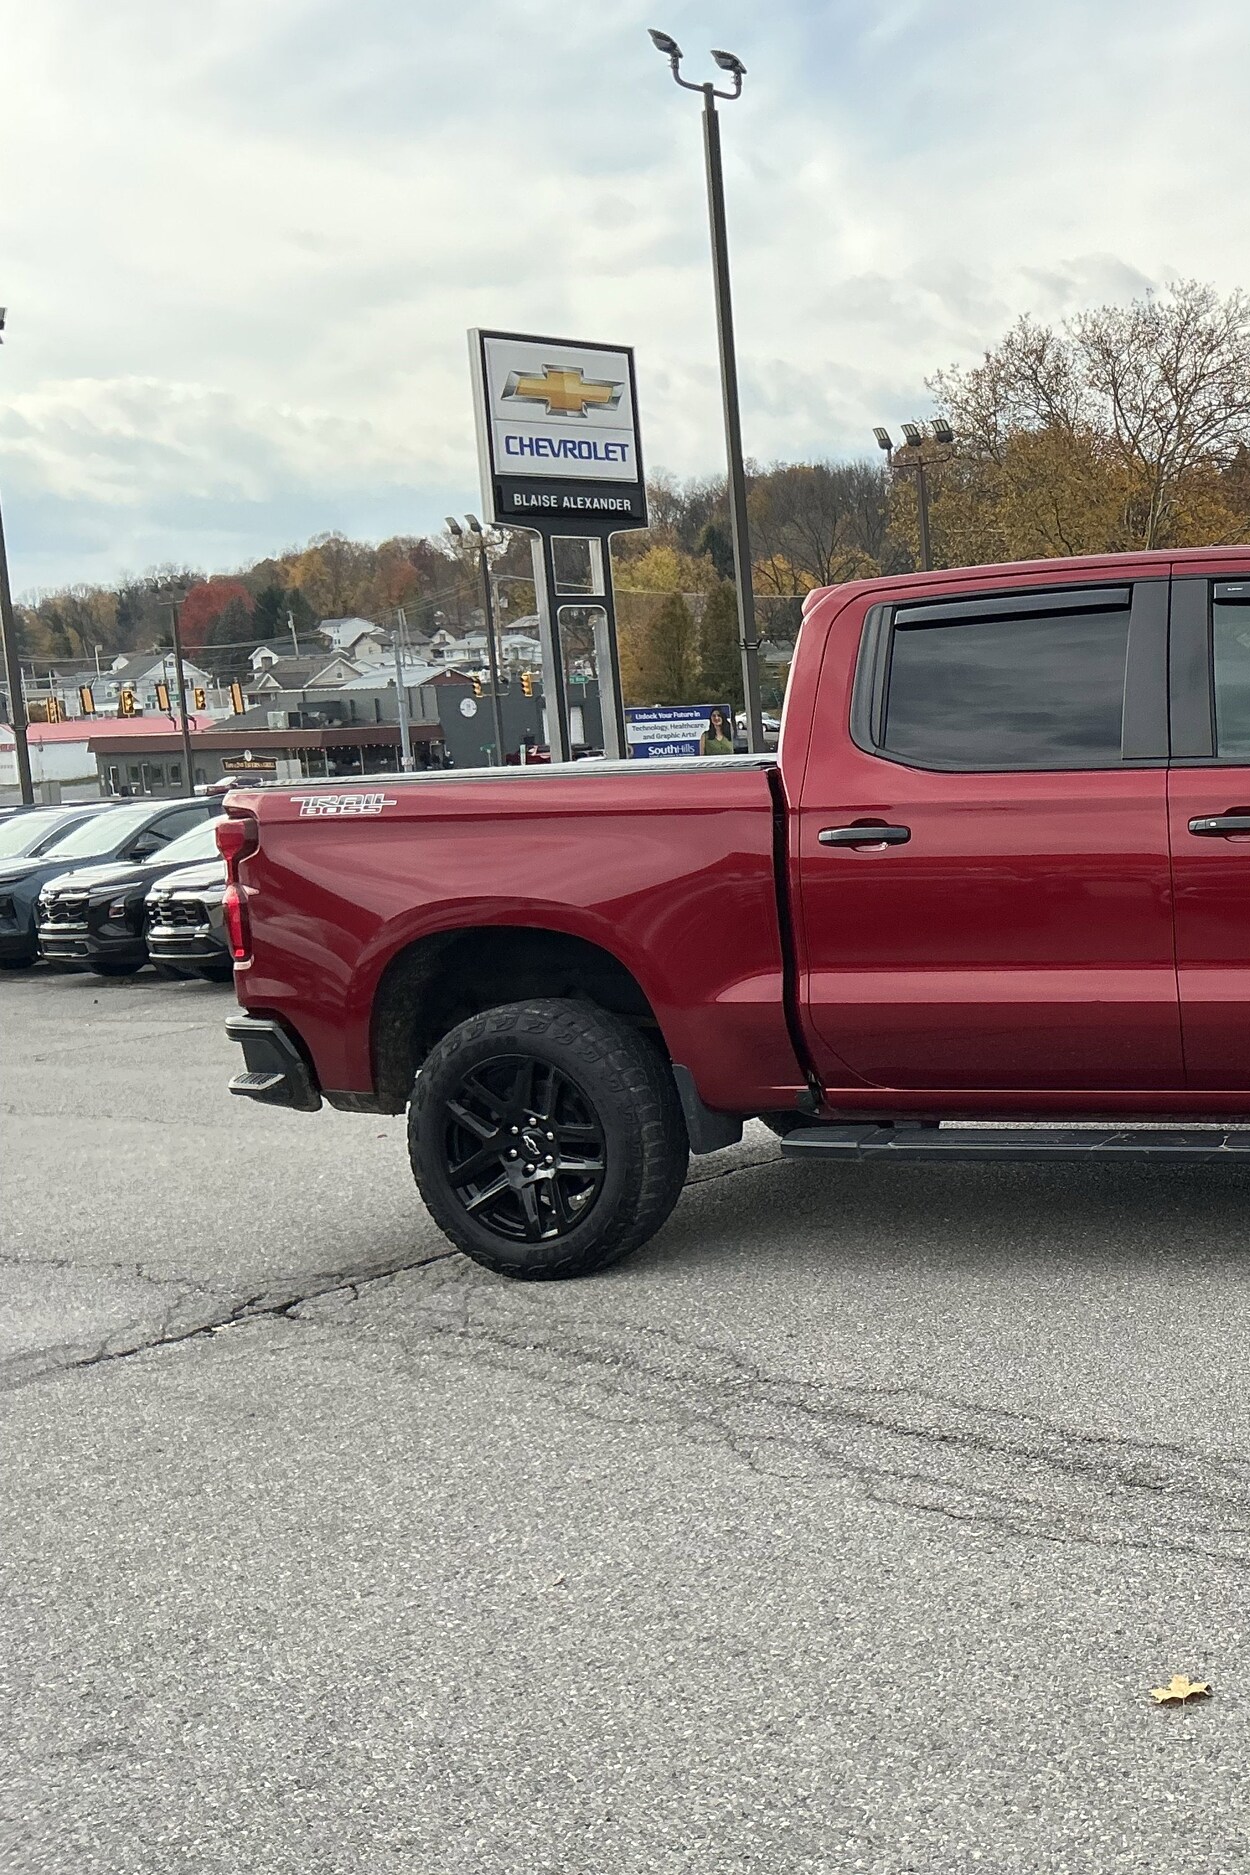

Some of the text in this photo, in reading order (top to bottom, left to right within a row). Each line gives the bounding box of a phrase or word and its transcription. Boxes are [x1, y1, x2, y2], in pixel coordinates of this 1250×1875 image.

[505, 435, 629, 462] CHEVROLET
[513, 493, 631, 511] BLAISE ALEXANDER
[635, 712, 657, 720] Unlock
[290, 793, 398, 807] TRAIL
[299, 805, 383, 817] BOSS
